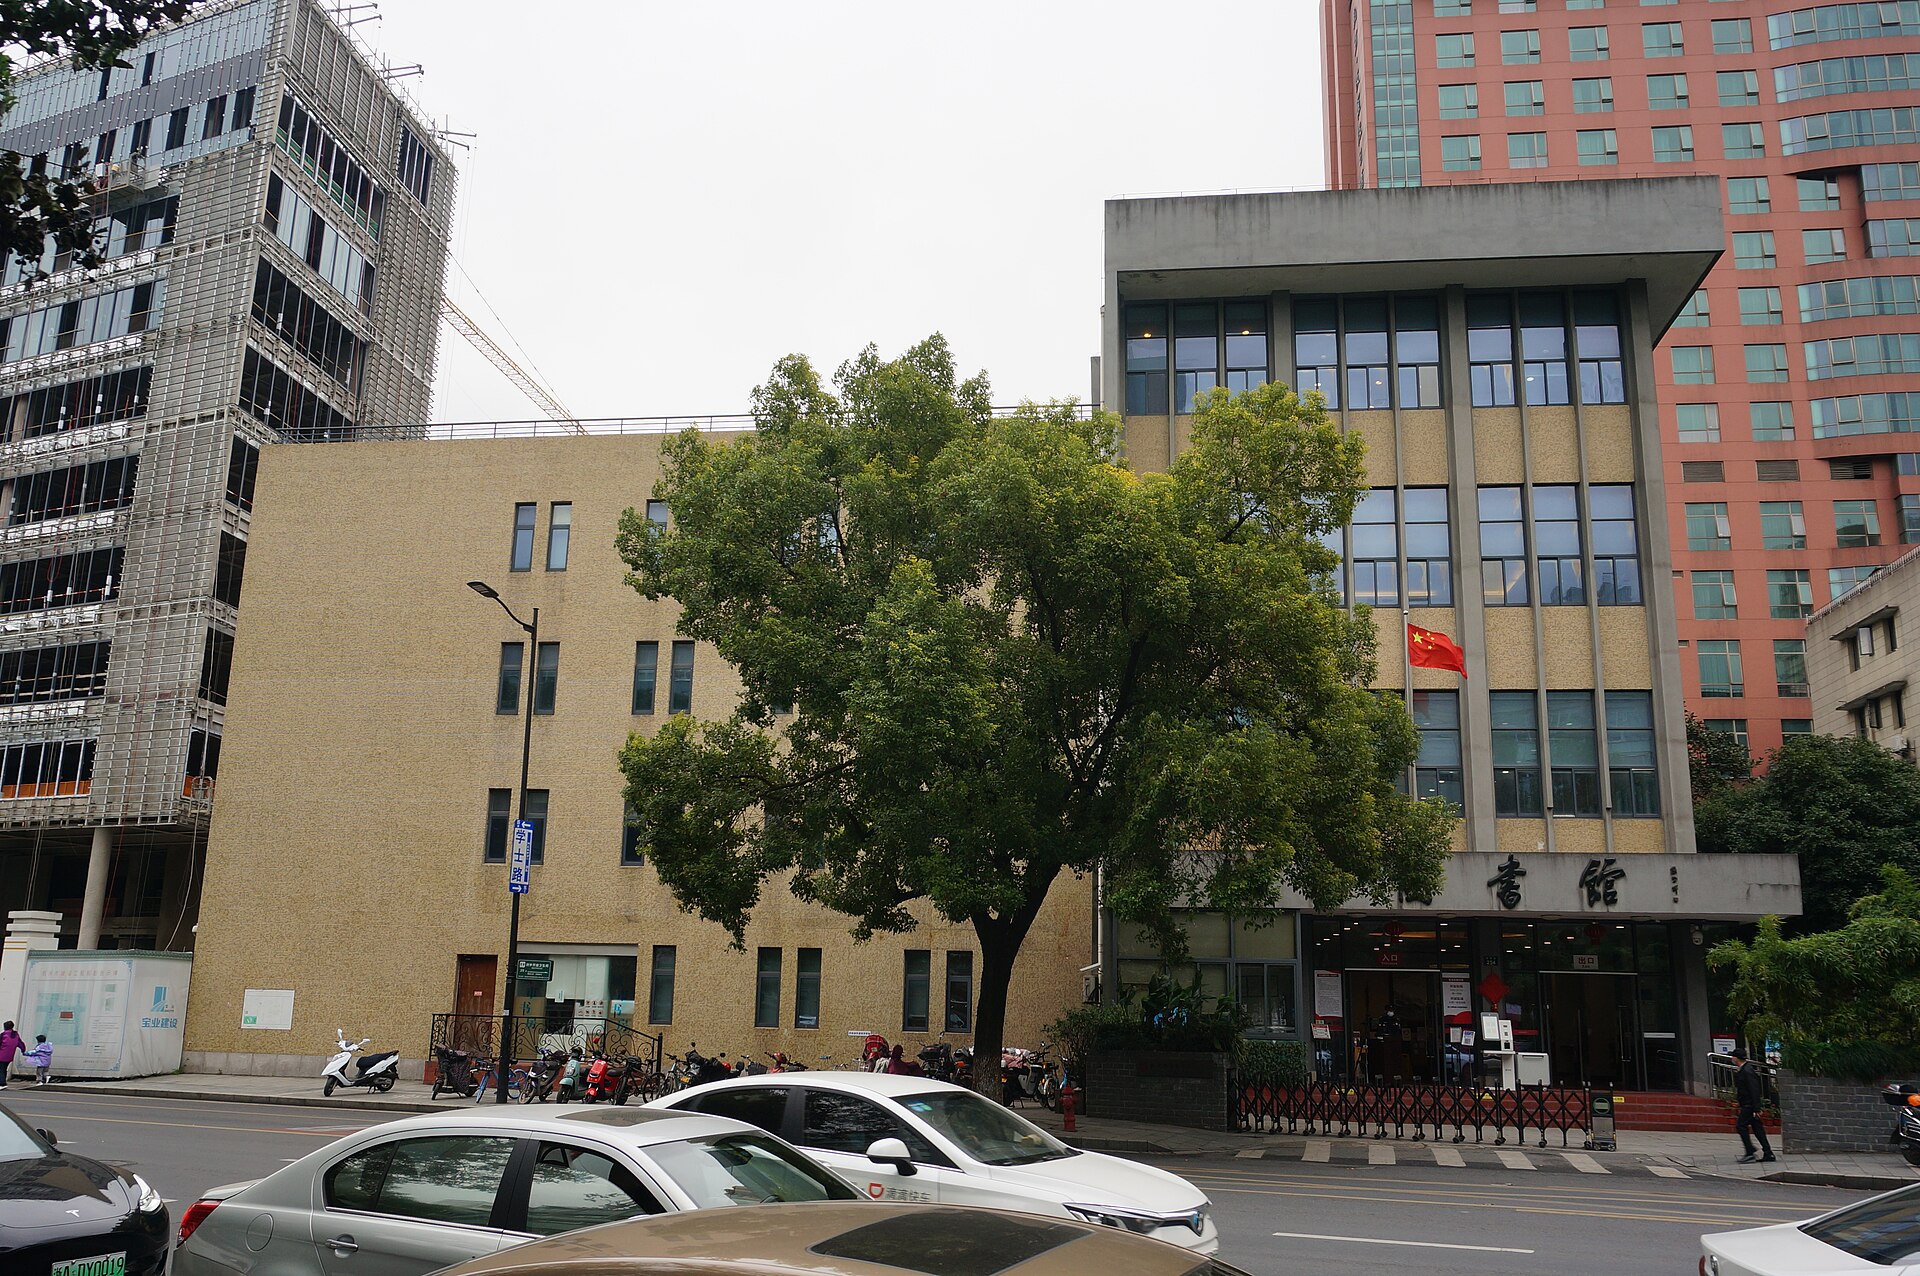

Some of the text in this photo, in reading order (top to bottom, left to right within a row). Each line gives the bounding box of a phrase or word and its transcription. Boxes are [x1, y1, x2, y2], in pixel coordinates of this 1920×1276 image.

[511, 829, 526, 882] 学士路
[1382, 953, 1398, 962] 入口
[1578, 956, 1595, 965] 出口
[141, 1017, 178, 1029] 宝业建设
